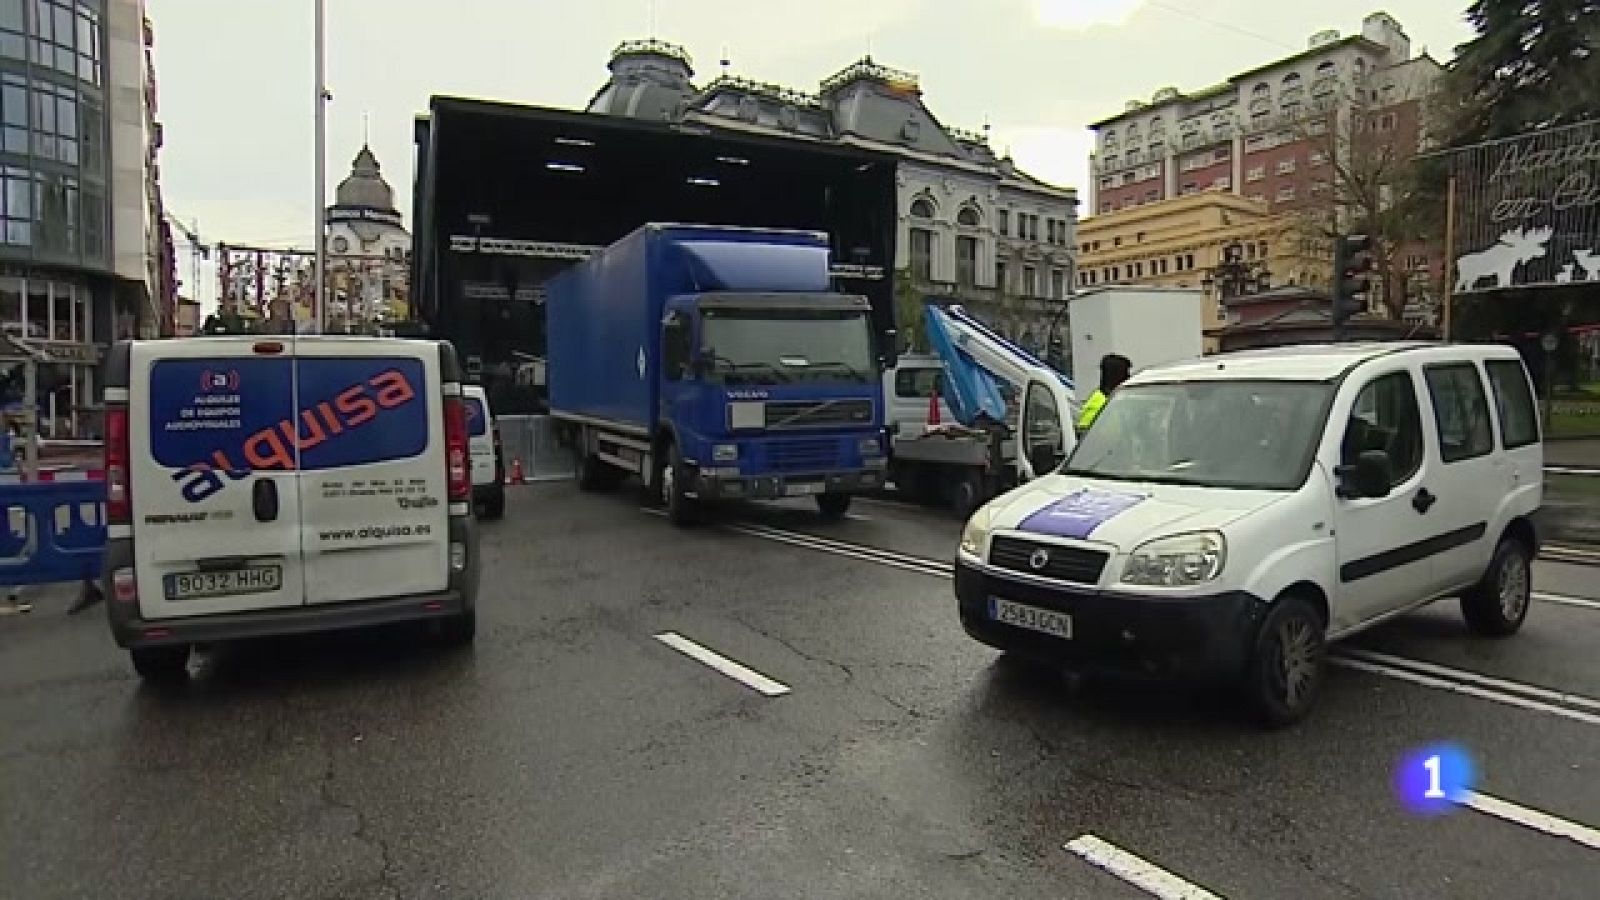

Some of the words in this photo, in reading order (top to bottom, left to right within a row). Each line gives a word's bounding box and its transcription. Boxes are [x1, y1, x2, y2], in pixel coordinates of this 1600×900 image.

[726, 390, 769, 399] VOLVO
[170, 368, 416, 503] alquisa
[319, 524, 432, 541] www.alquisa.es
[178, 572, 232, 593] 9032
[236, 569, 275, 587] HHG
[1000, 601, 1036, 626] 2583
[1038, 611, 1069, 635] GCN
